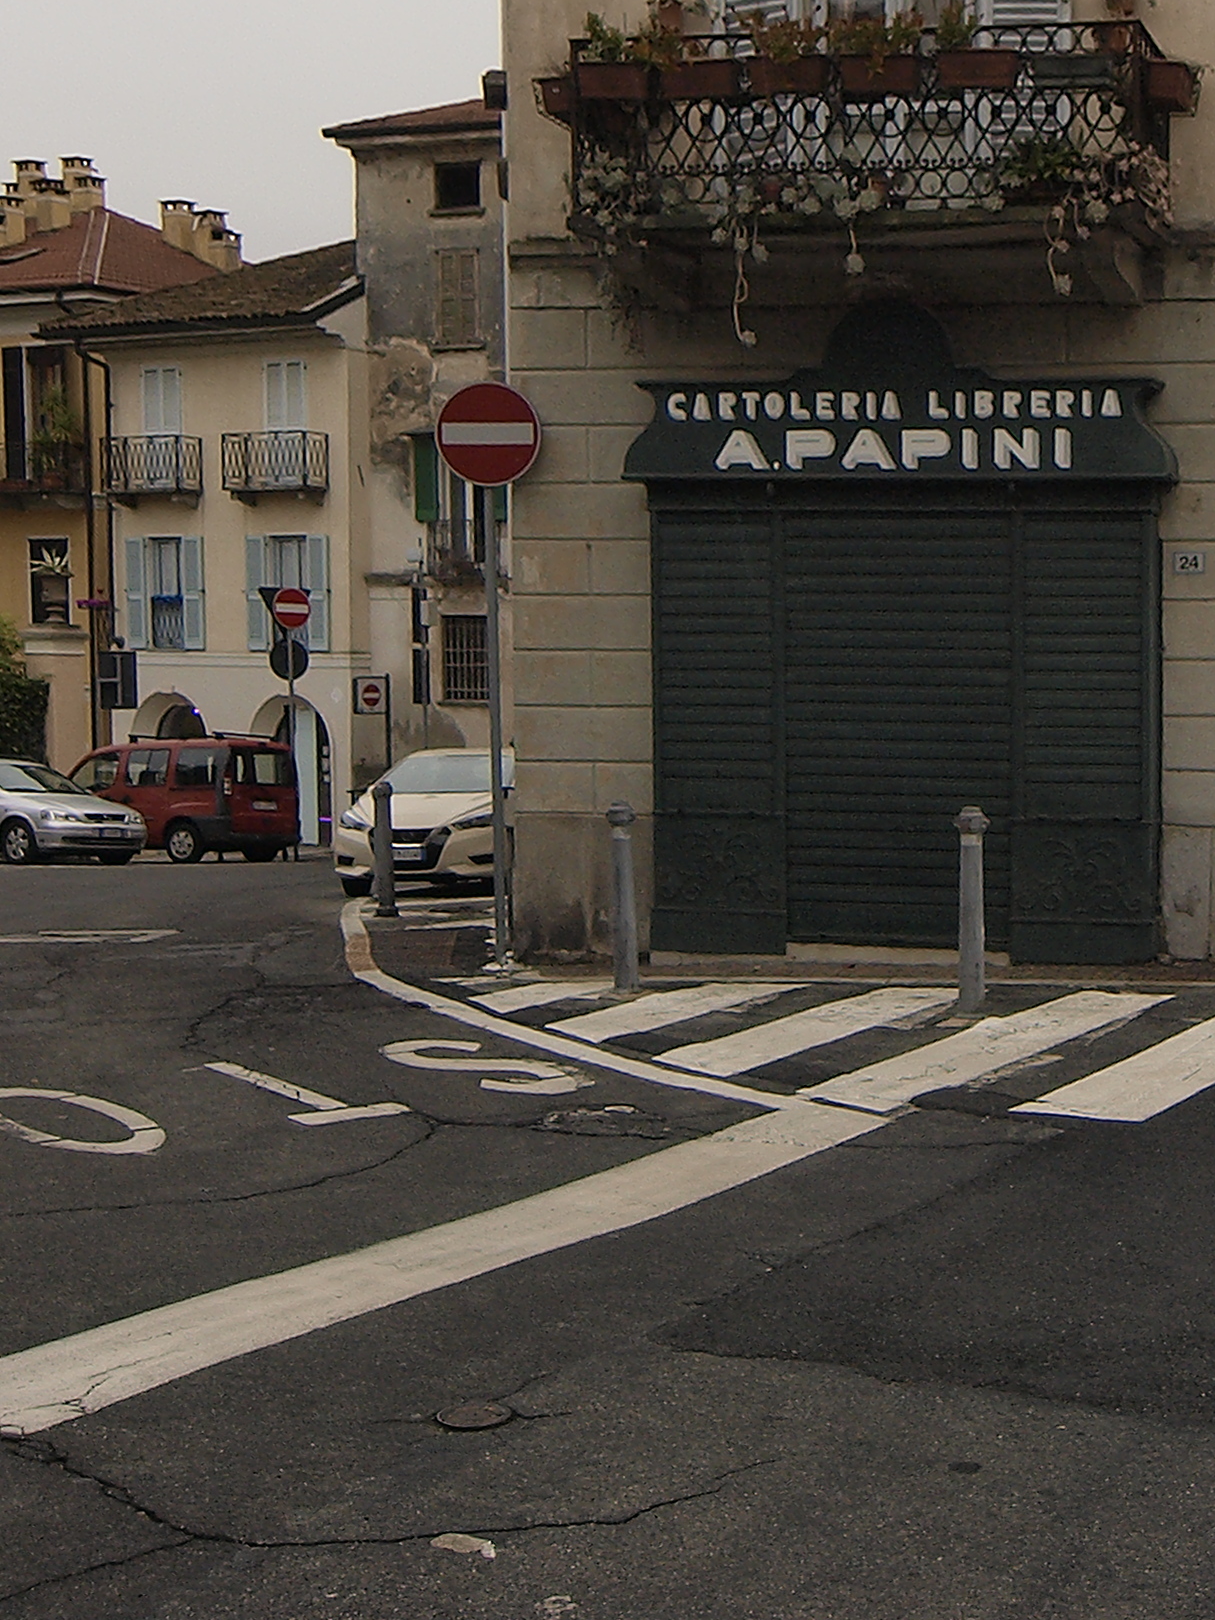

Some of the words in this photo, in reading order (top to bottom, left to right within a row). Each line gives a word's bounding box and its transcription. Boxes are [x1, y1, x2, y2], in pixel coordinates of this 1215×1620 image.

[666, 389, 902, 421] CARTOLERIA
[927, 388, 1123, 420] LIBRERIA
[1179, 555, 1199, 570] 24
